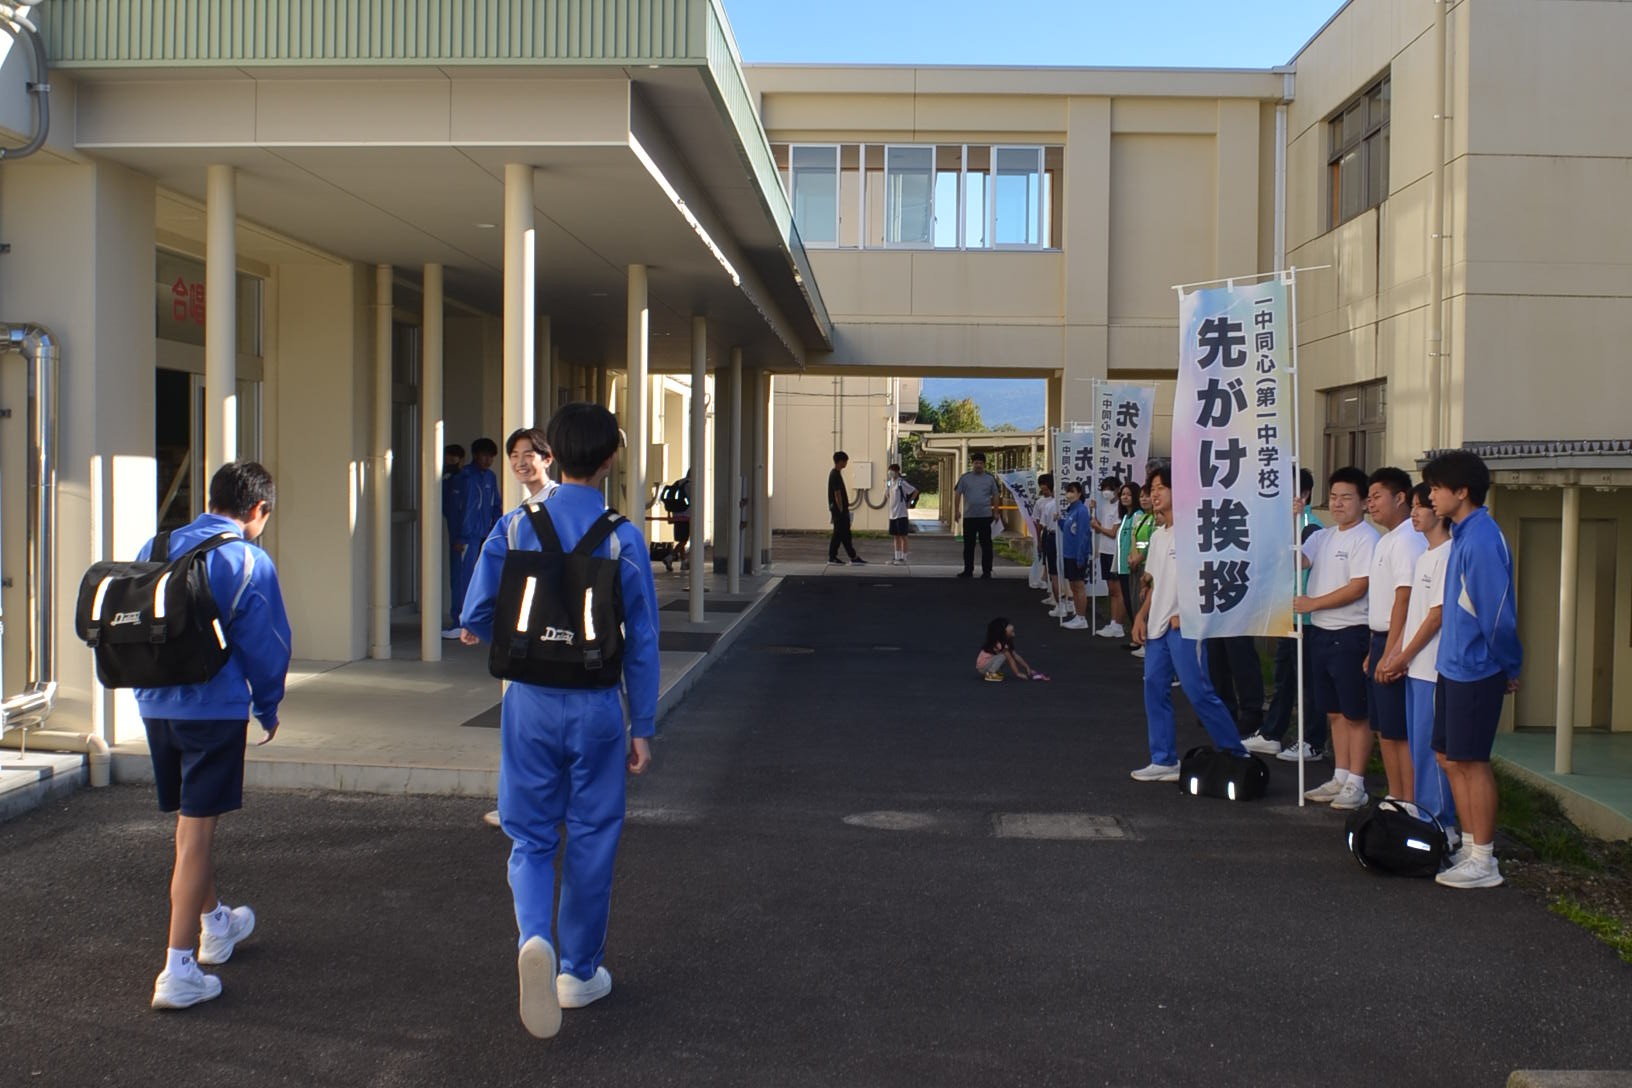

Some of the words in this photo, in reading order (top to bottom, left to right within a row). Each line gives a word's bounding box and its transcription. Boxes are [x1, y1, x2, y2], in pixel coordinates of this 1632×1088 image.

[1196, 316, 1251, 615] 先がけ挨拶
[1254, 297, 1280, 499] 一中同心（第一中学校）
